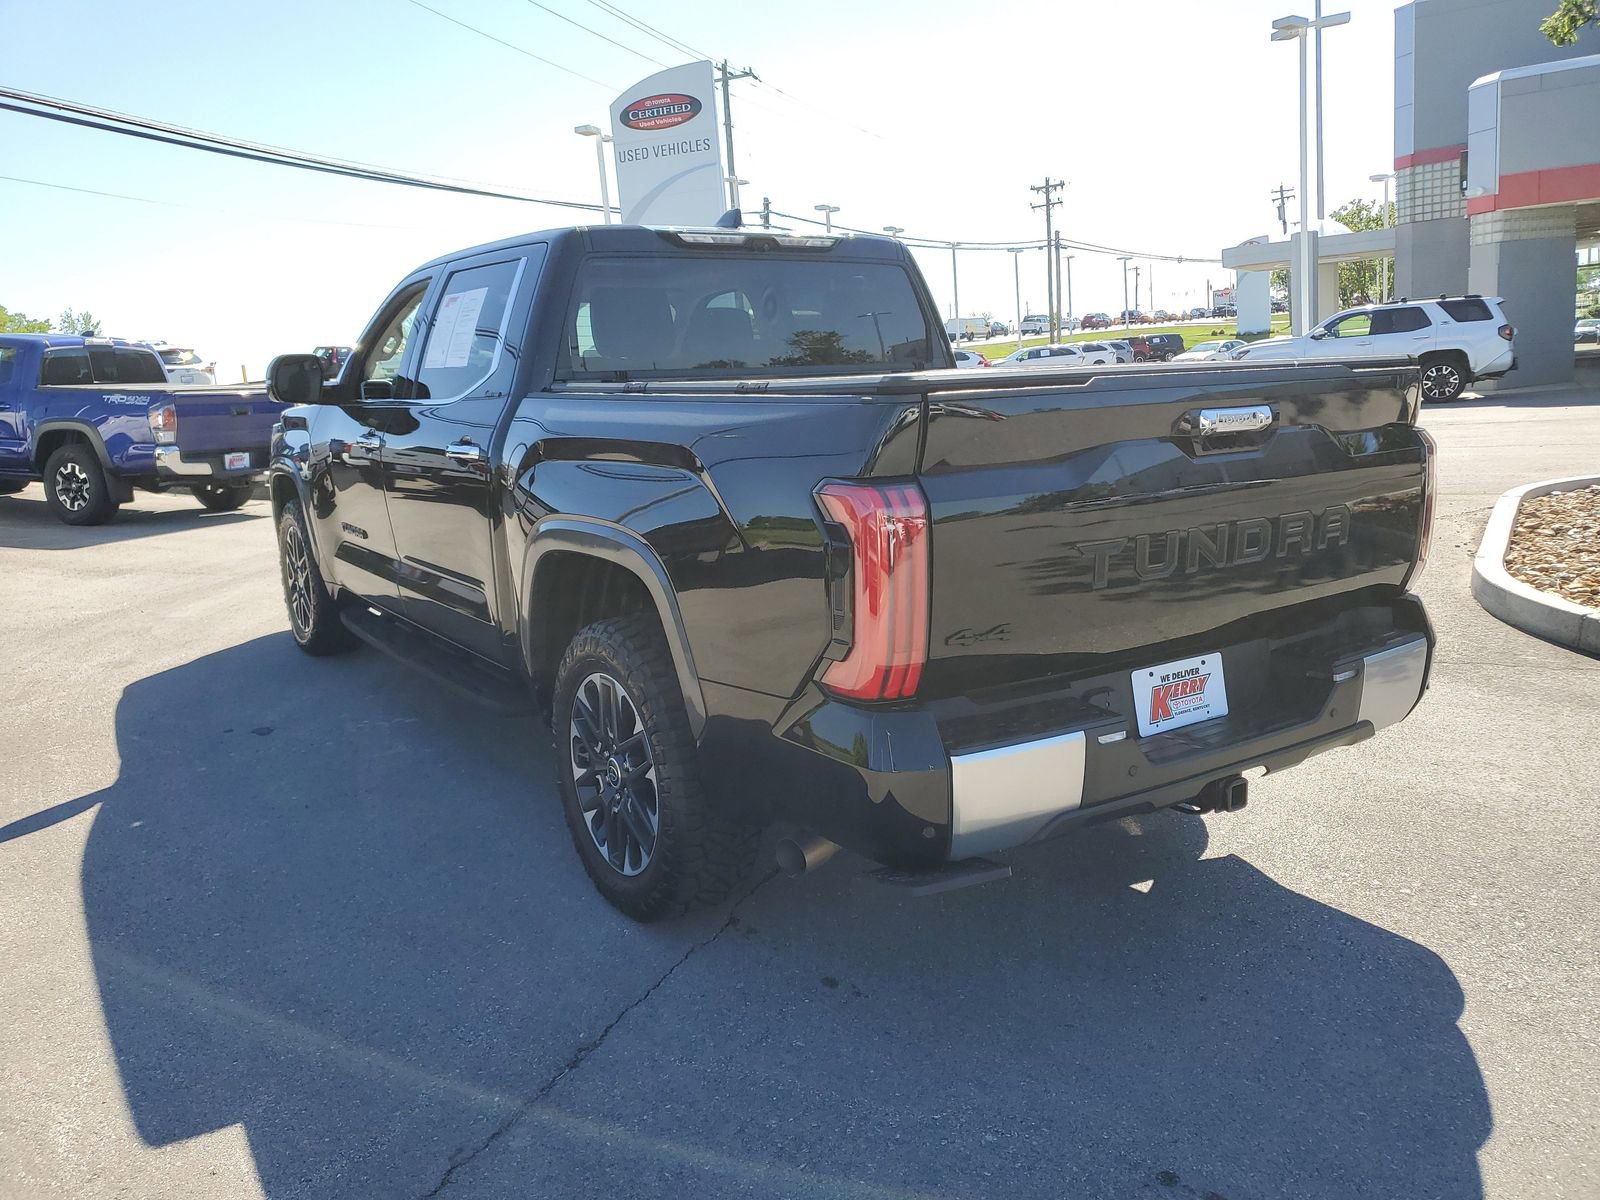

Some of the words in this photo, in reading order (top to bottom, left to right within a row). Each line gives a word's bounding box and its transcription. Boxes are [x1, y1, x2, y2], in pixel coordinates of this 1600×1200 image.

[651, 98, 671, 106] TOYOTA
[628, 103, 692, 121] CERTIFIED
[639, 120, 655, 128] Used
[656, 116, 682, 125] Vehicles
[618, 147, 649, 164] USED
[652, 138, 711, 158] VEHICLES
[1074, 503, 1351, 590] TUNDRA
[1160, 673, 1170, 683] WE
[1172, 667, 1200, 680] DELIVER
[1150, 674, 1209, 724] KERRY
[1181, 696, 1203, 707] TOYOTA
